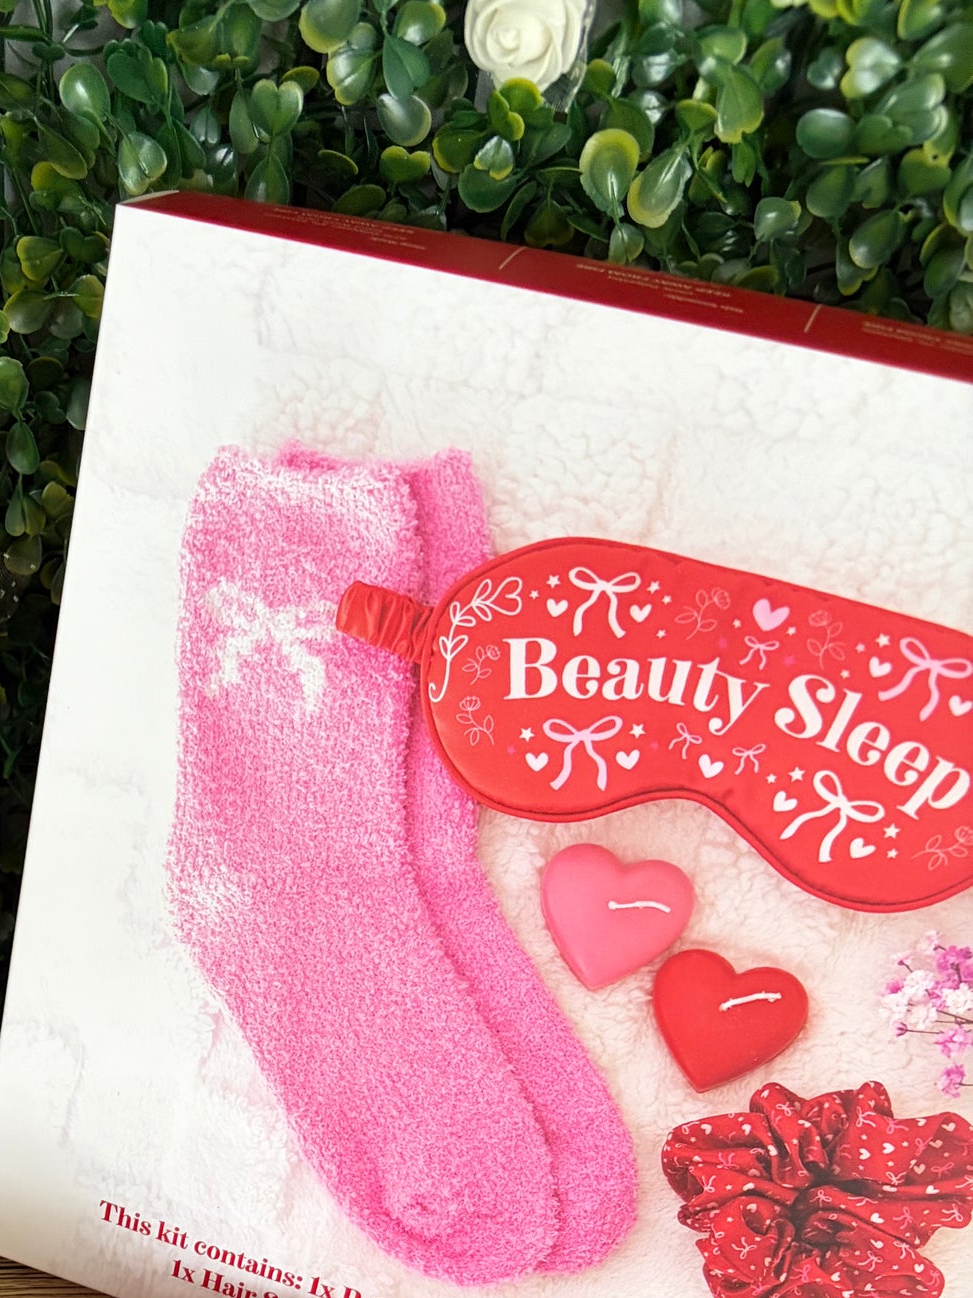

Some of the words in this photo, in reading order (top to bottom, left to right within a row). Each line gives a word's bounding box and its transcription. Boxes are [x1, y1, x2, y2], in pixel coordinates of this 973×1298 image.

[502, 637, 770, 735] Beauty
[775, 675, 970, 819] Sleep
[101, 1201, 150, 1234] This
[156, 1221, 188, 1249] kit
[195, 1242, 302, 1289] contains:
[172, 1260, 195, 1283] 1x
